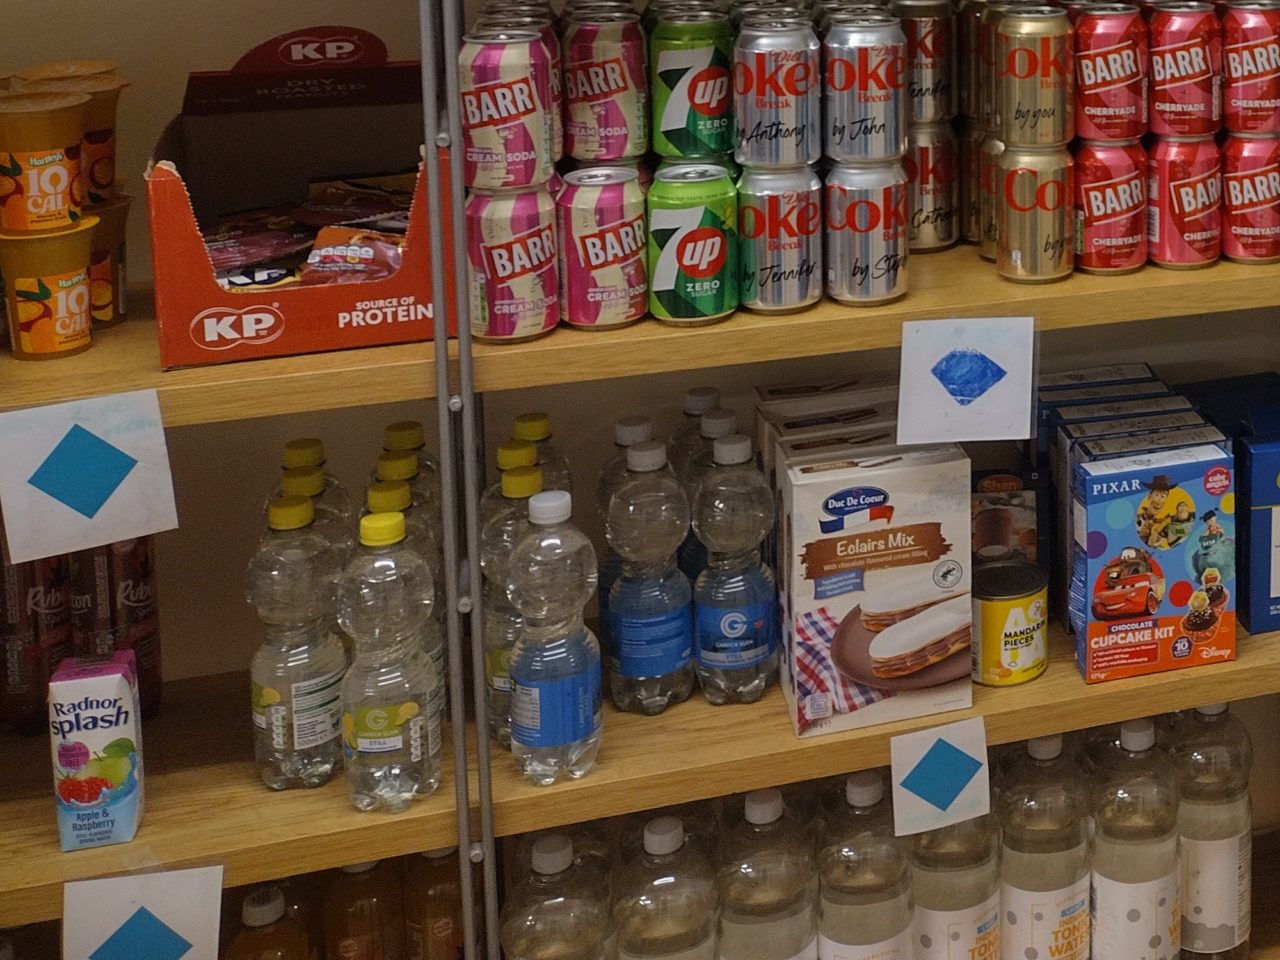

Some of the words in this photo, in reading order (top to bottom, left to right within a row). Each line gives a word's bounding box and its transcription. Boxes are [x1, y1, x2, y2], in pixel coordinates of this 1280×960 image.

[291, 42, 355, 60] KP
[1081, 48, 1138, 87] BARR
[1152, 46, 1205, 82] BARR
[566, 61, 625, 101] BARR
[733, 52, 812, 98] oke
[658, 48, 715, 132] 7
[694, 74, 729, 107] up
[465, 82, 535, 125] BARR
[1084, 106, 1136, 116] CHERRYADE
[1155, 101, 1205, 112] CHERRYADE
[1231, 99, 1280, 108] CHERRYADE
[599, 126, 628, 137] SODA
[698, 118, 728, 129] ZERO
[748, 119, 806, 147] Anthony
[832, 118, 845, 144] by
[850, 117, 885, 141] John
[466, 150, 501, 164] CREAM
[506, 149, 537, 162] SODA
[27, 165, 69, 197] 10
[27, 194, 68, 214] CAL
[1090, 177, 1143, 217] BARR
[738, 194, 821, 240] oke
[1092, 234, 1142, 246] CHERRYADE
[1231, 225, 1280, 236] CHERRYADE
[492, 228, 555, 280] BARR
[585, 220, 646, 269] BARR
[651, 206, 705, 291] 7
[683, 236, 722, 271] up
[759, 260, 817, 288] Jennifer
[852, 261, 868, 284] by
[588, 289, 625, 302] CREAM
[686, 280, 721, 292] ZERO
[56, 284, 90, 318] 10
[356, 297, 397, 311] SOURCE
[400, 296, 415, 306] OF
[494, 300, 534, 315] CREAM
[56, 313, 90, 335] CAL
[338, 304, 434, 329] PROTEIN
[203, 313, 275, 342] KP
[1092, 479, 1141, 495] PIXAR
[828, 499, 845, 509] Duc
[847, 497, 858, 506] De
[860, 495, 884, 505] Coeur
[888, 532, 915, 548] Mix
[1110, 620, 1153, 632] CHOCOLATE
[1004, 635, 1035, 648] PIECES
[1091, 630, 1152, 649] CUPCAKE
[1155, 626, 1175, 639] KIT
[1174, 641, 1188, 651] 10
[1199, 646, 1232, 659] Disney
[53, 697, 122, 717] Radnor
[51, 704, 129, 740] splash
[72, 818, 115, 832] Raspberry
[76, 810, 100, 822] Apple
[102, 808, 109, 817] &
